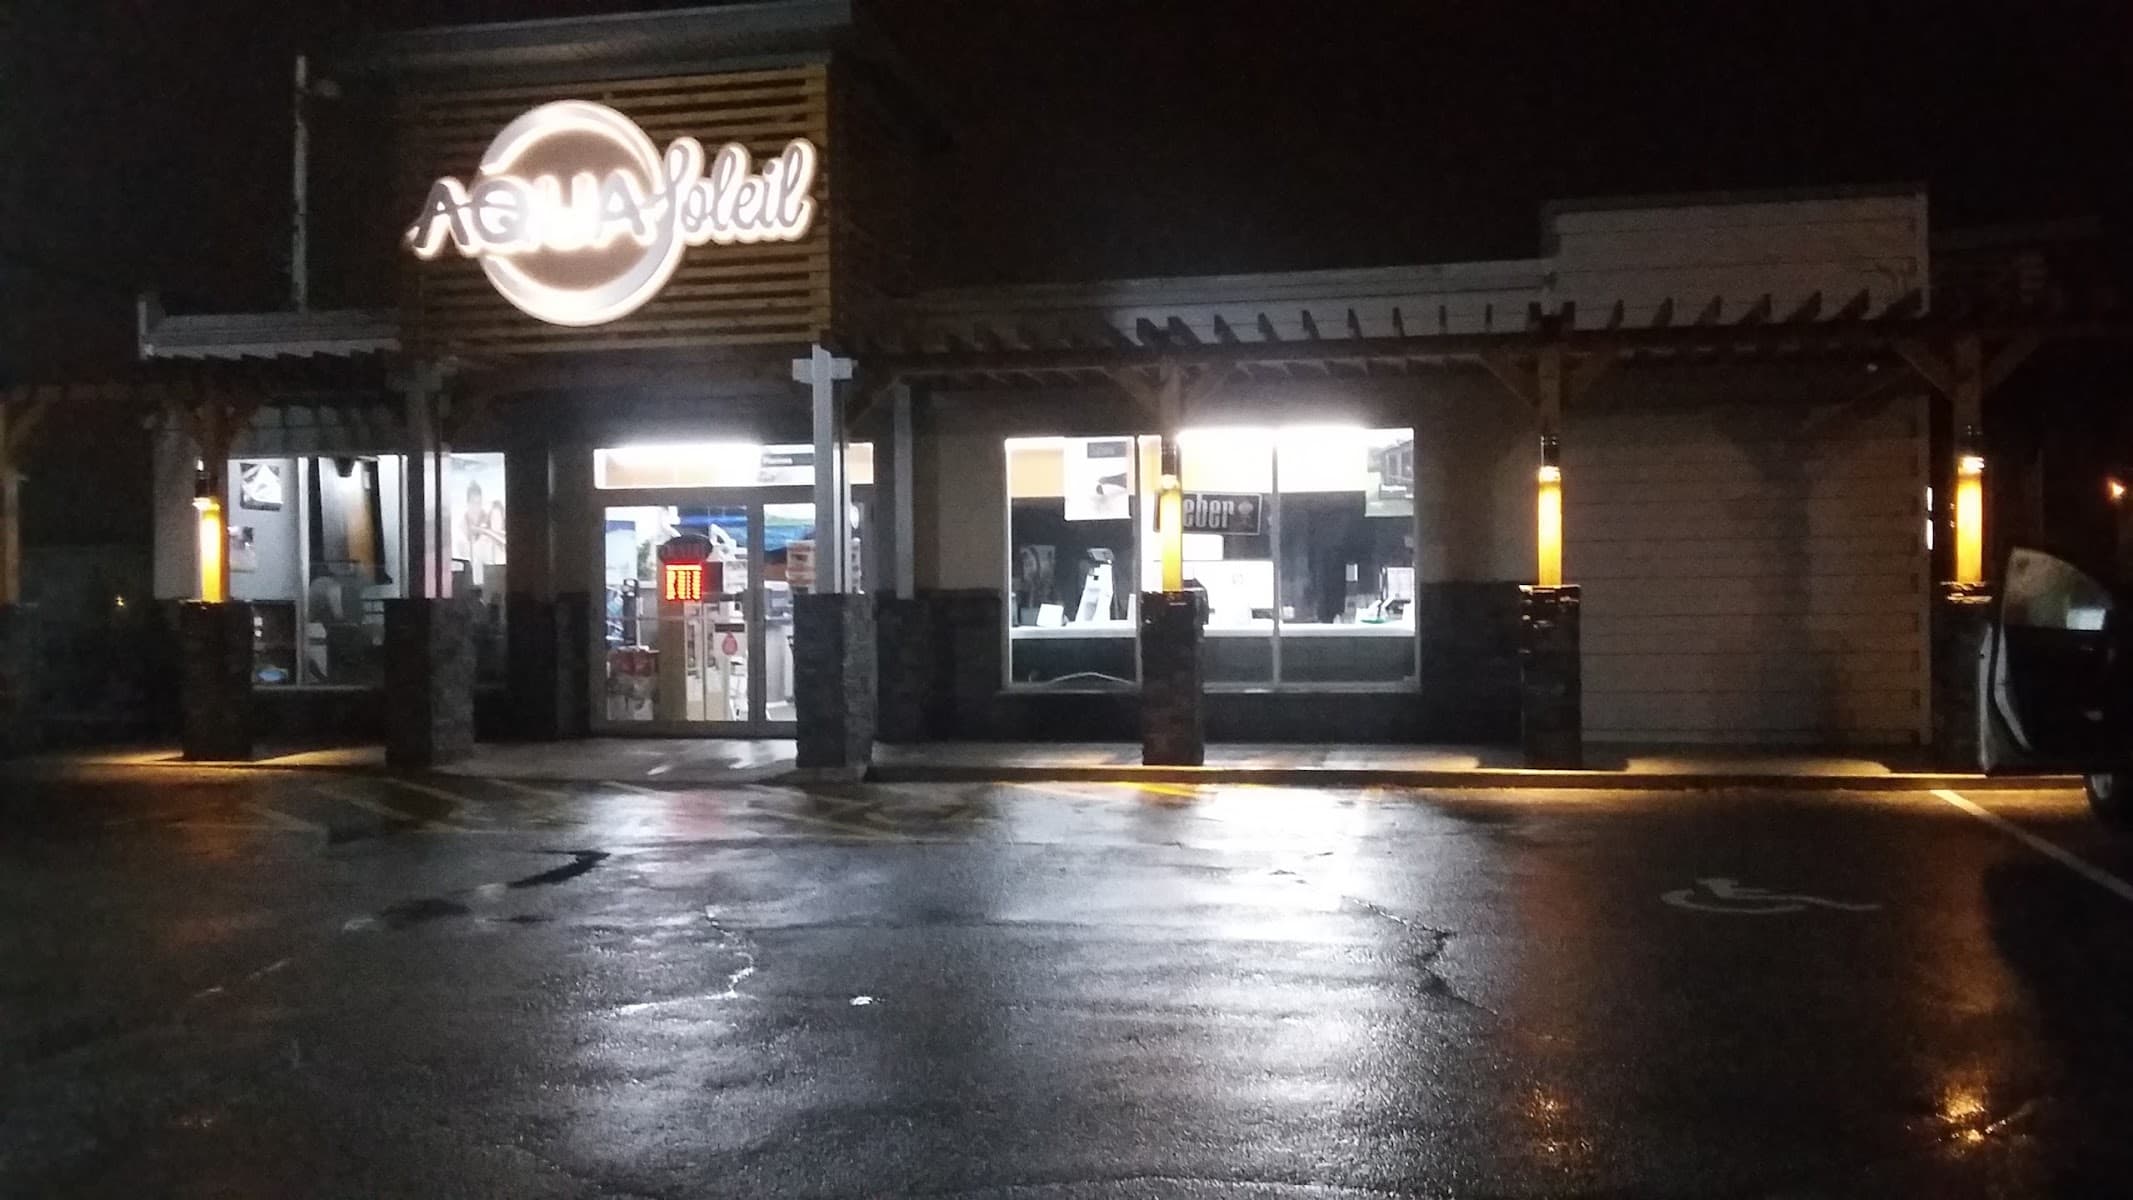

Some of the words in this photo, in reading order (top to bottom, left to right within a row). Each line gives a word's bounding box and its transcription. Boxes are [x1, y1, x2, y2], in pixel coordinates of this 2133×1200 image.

[408, 169, 658, 256] AQUA
[655, 138, 814, 244] Soleil
[1181, 493, 1235, 528] eber
